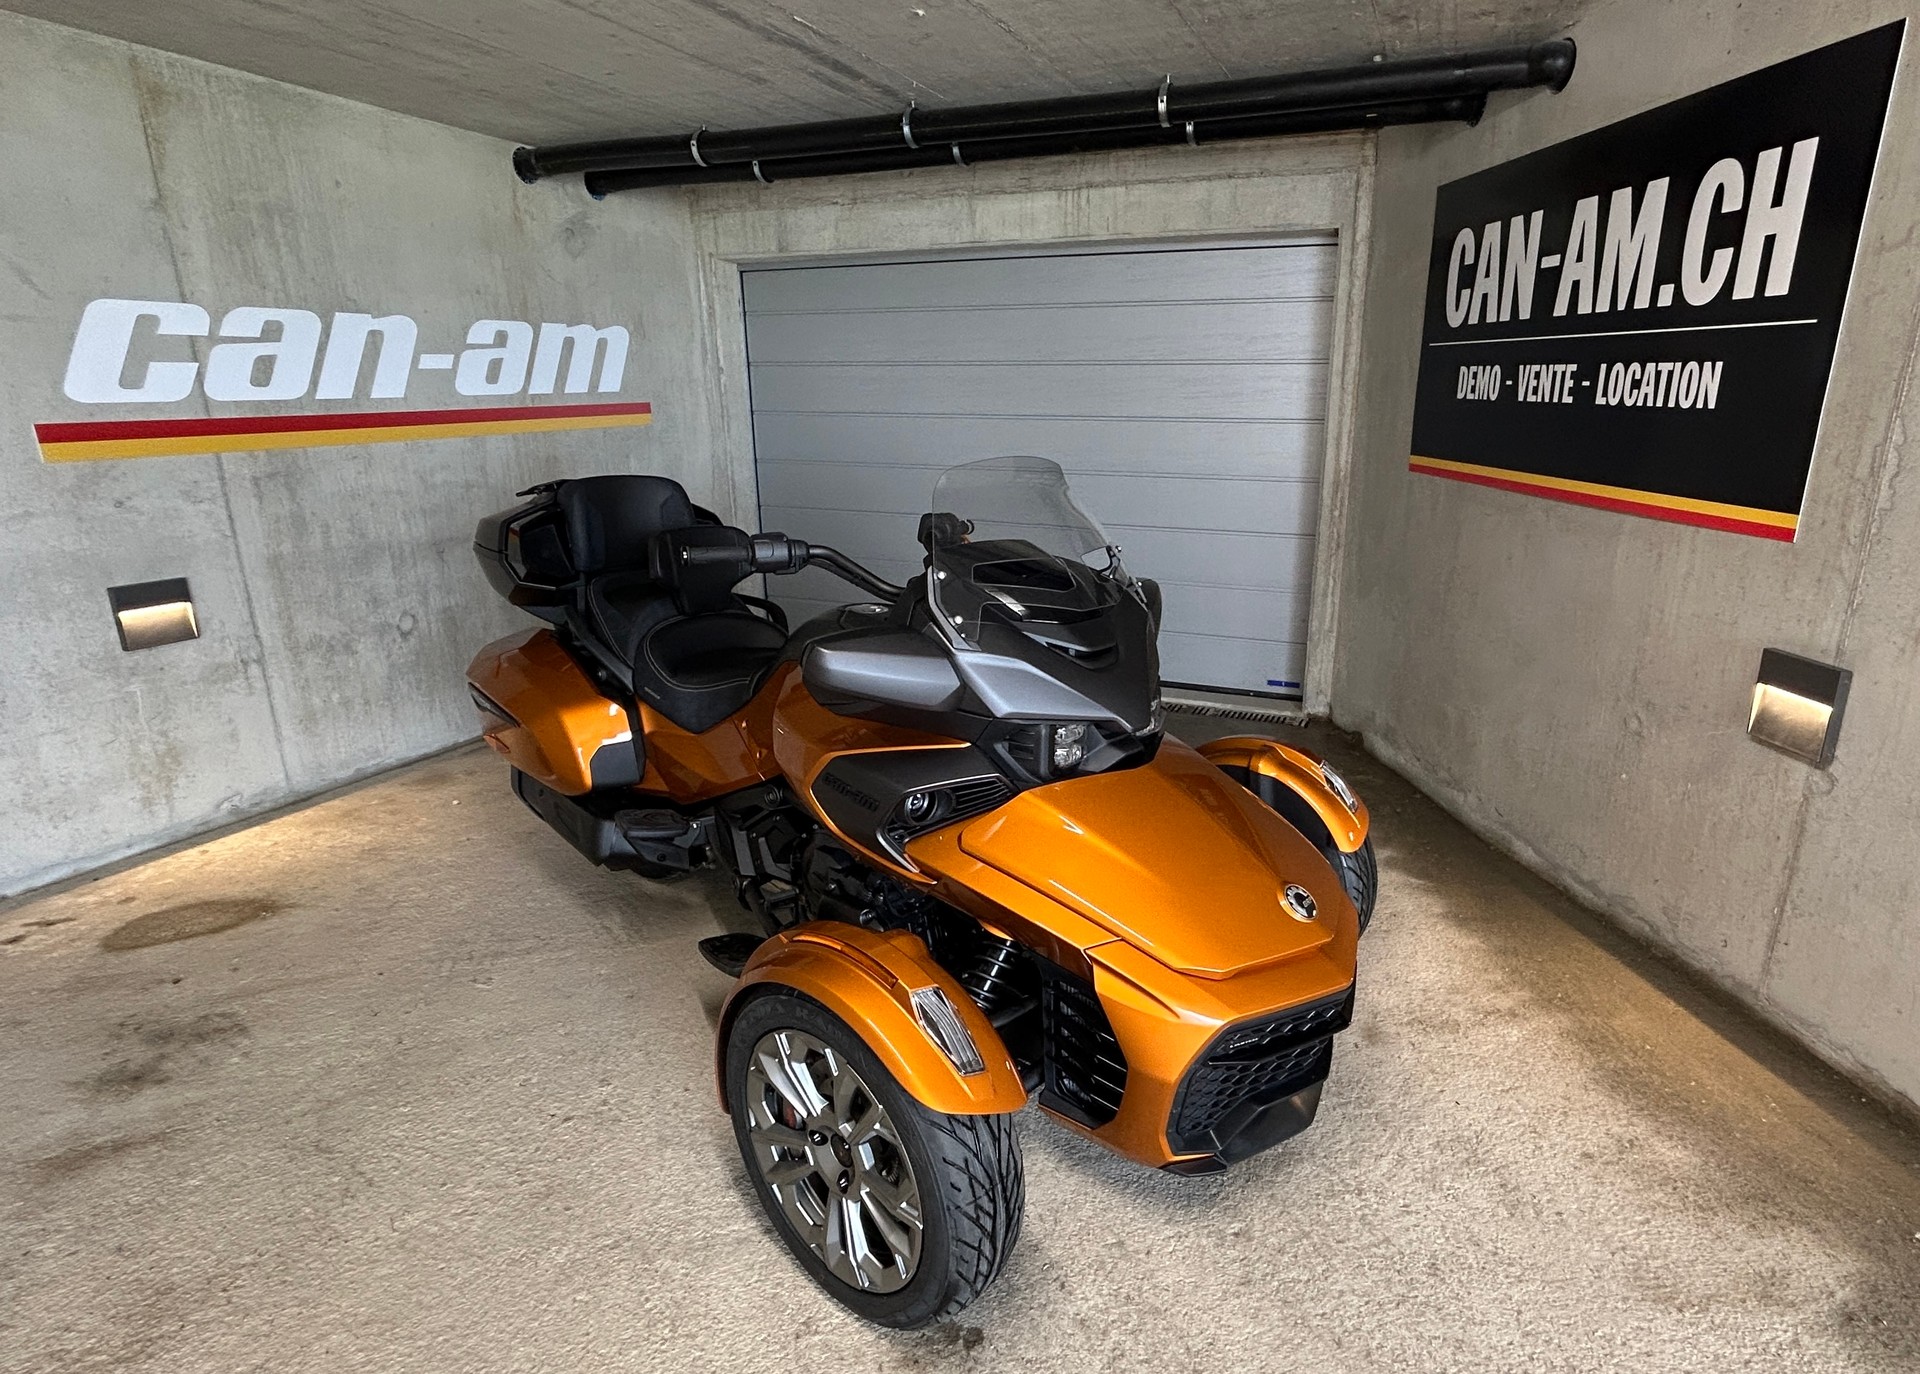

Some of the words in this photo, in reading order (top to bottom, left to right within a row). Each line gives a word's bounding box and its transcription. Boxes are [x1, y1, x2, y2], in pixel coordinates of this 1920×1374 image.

[1446, 136, 1820, 328] CAN-AM.CH
[63, 298, 630, 403] can-am
[1456, 364, 1502, 401] DEMO
[1517, 363, 1578, 404] VENTE
[1594, 360, 1724, 410] LOCATION
